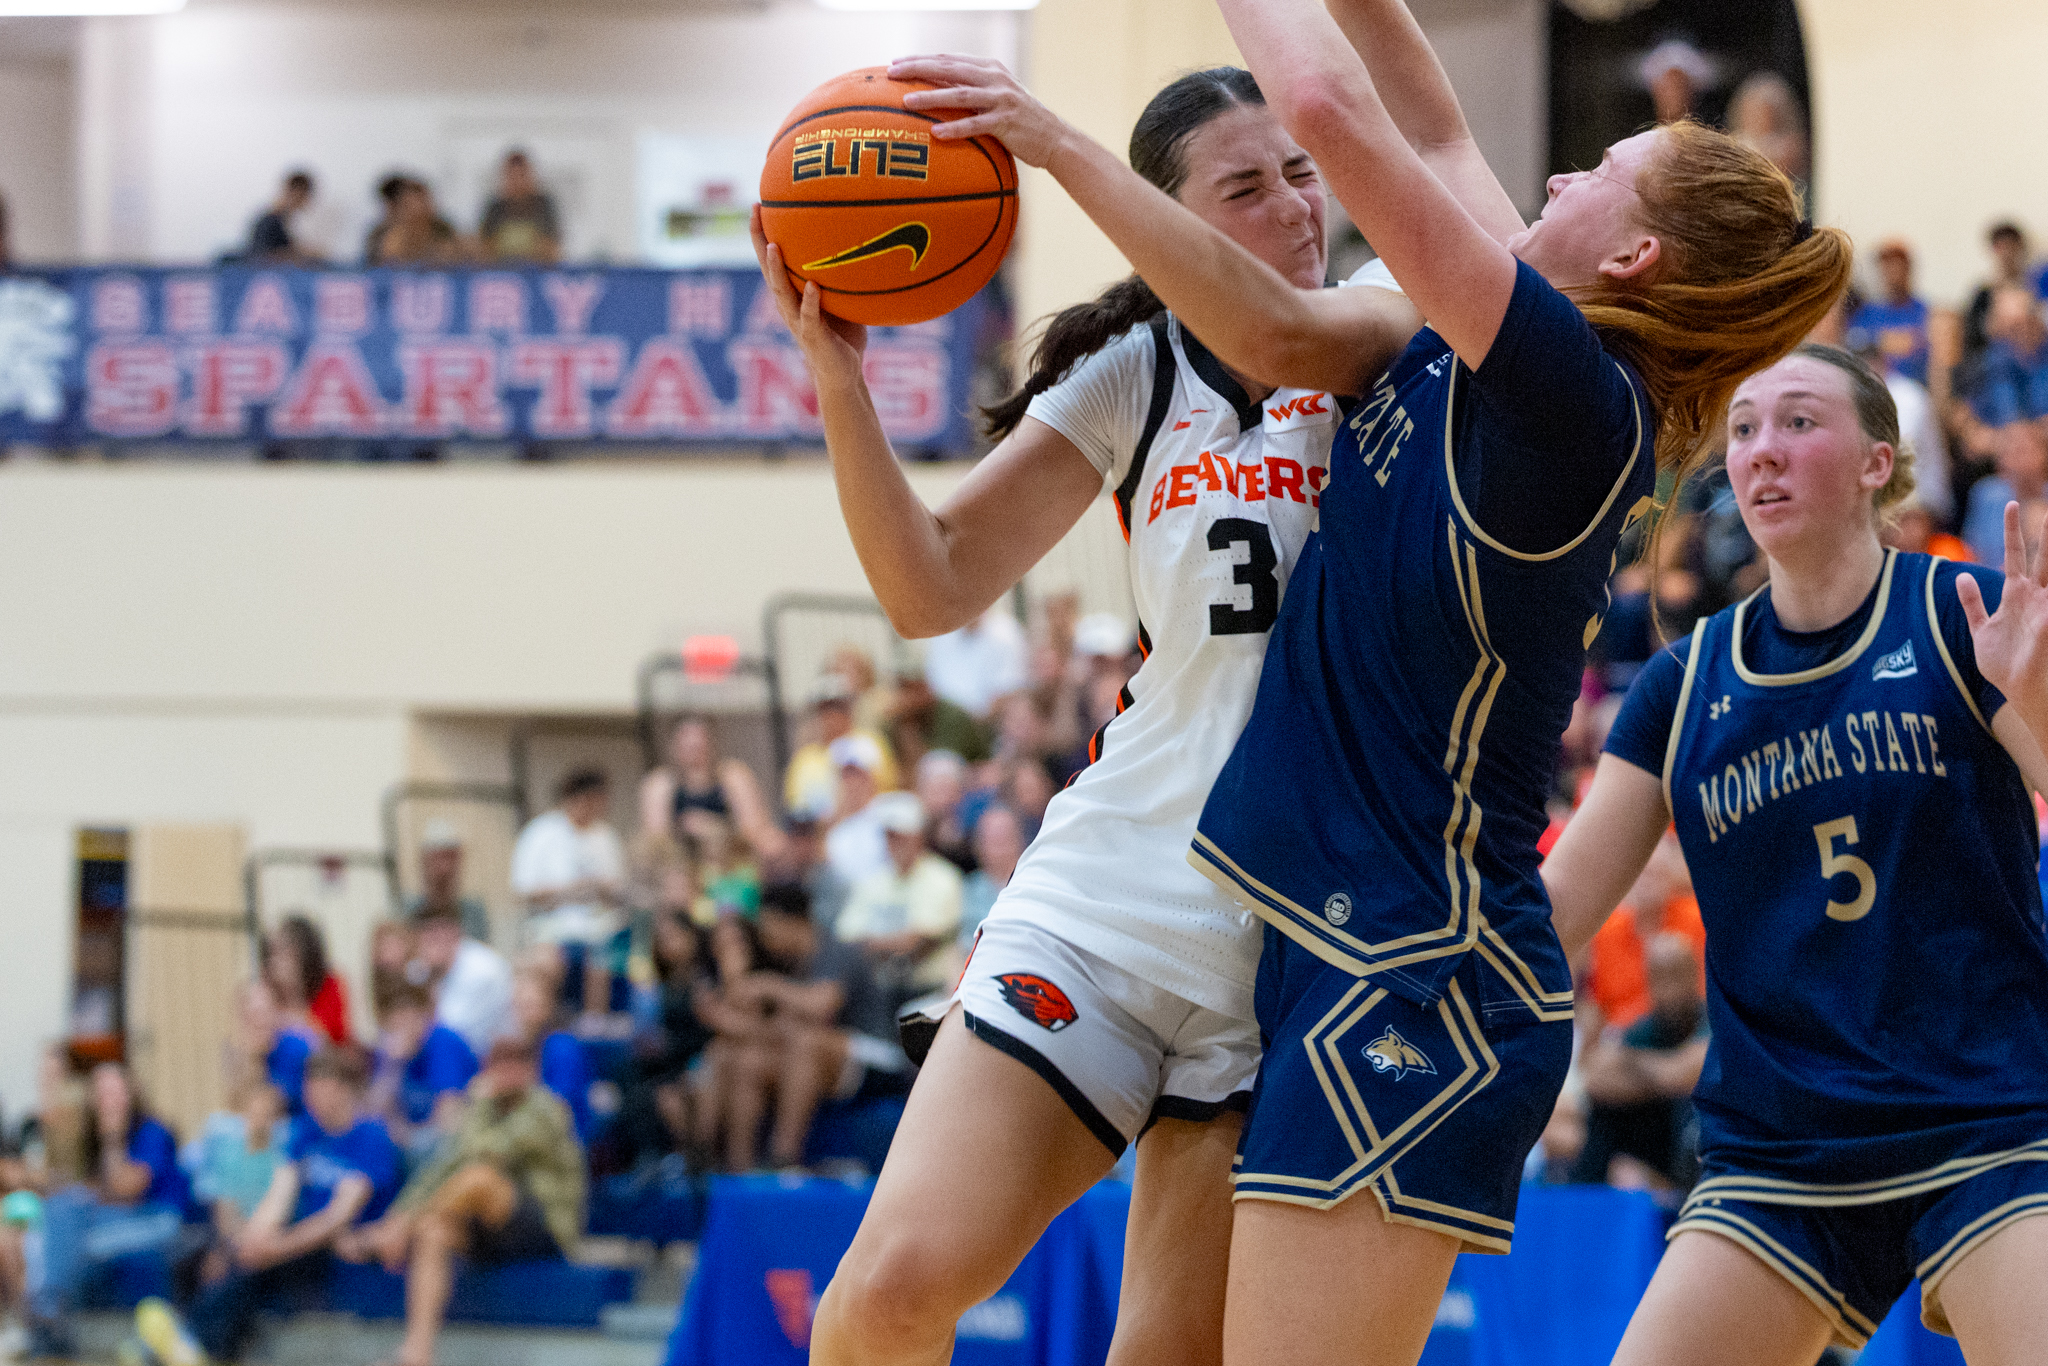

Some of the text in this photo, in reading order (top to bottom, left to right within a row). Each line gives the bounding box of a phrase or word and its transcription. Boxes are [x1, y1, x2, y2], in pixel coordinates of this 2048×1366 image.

[793, 138, 930, 184] ELITE
[795, 127, 931, 145] CHAMPIONSHIP
[92, 275, 603, 332] SEABURY
[86, 341, 951, 436] SPARTANS
[1267, 393, 1329, 422] WCC
[1207, 517, 1279, 636] 3
[1699, 710, 1947, 843] MONTANA STATE
[1812, 814, 1877, 922] 5
